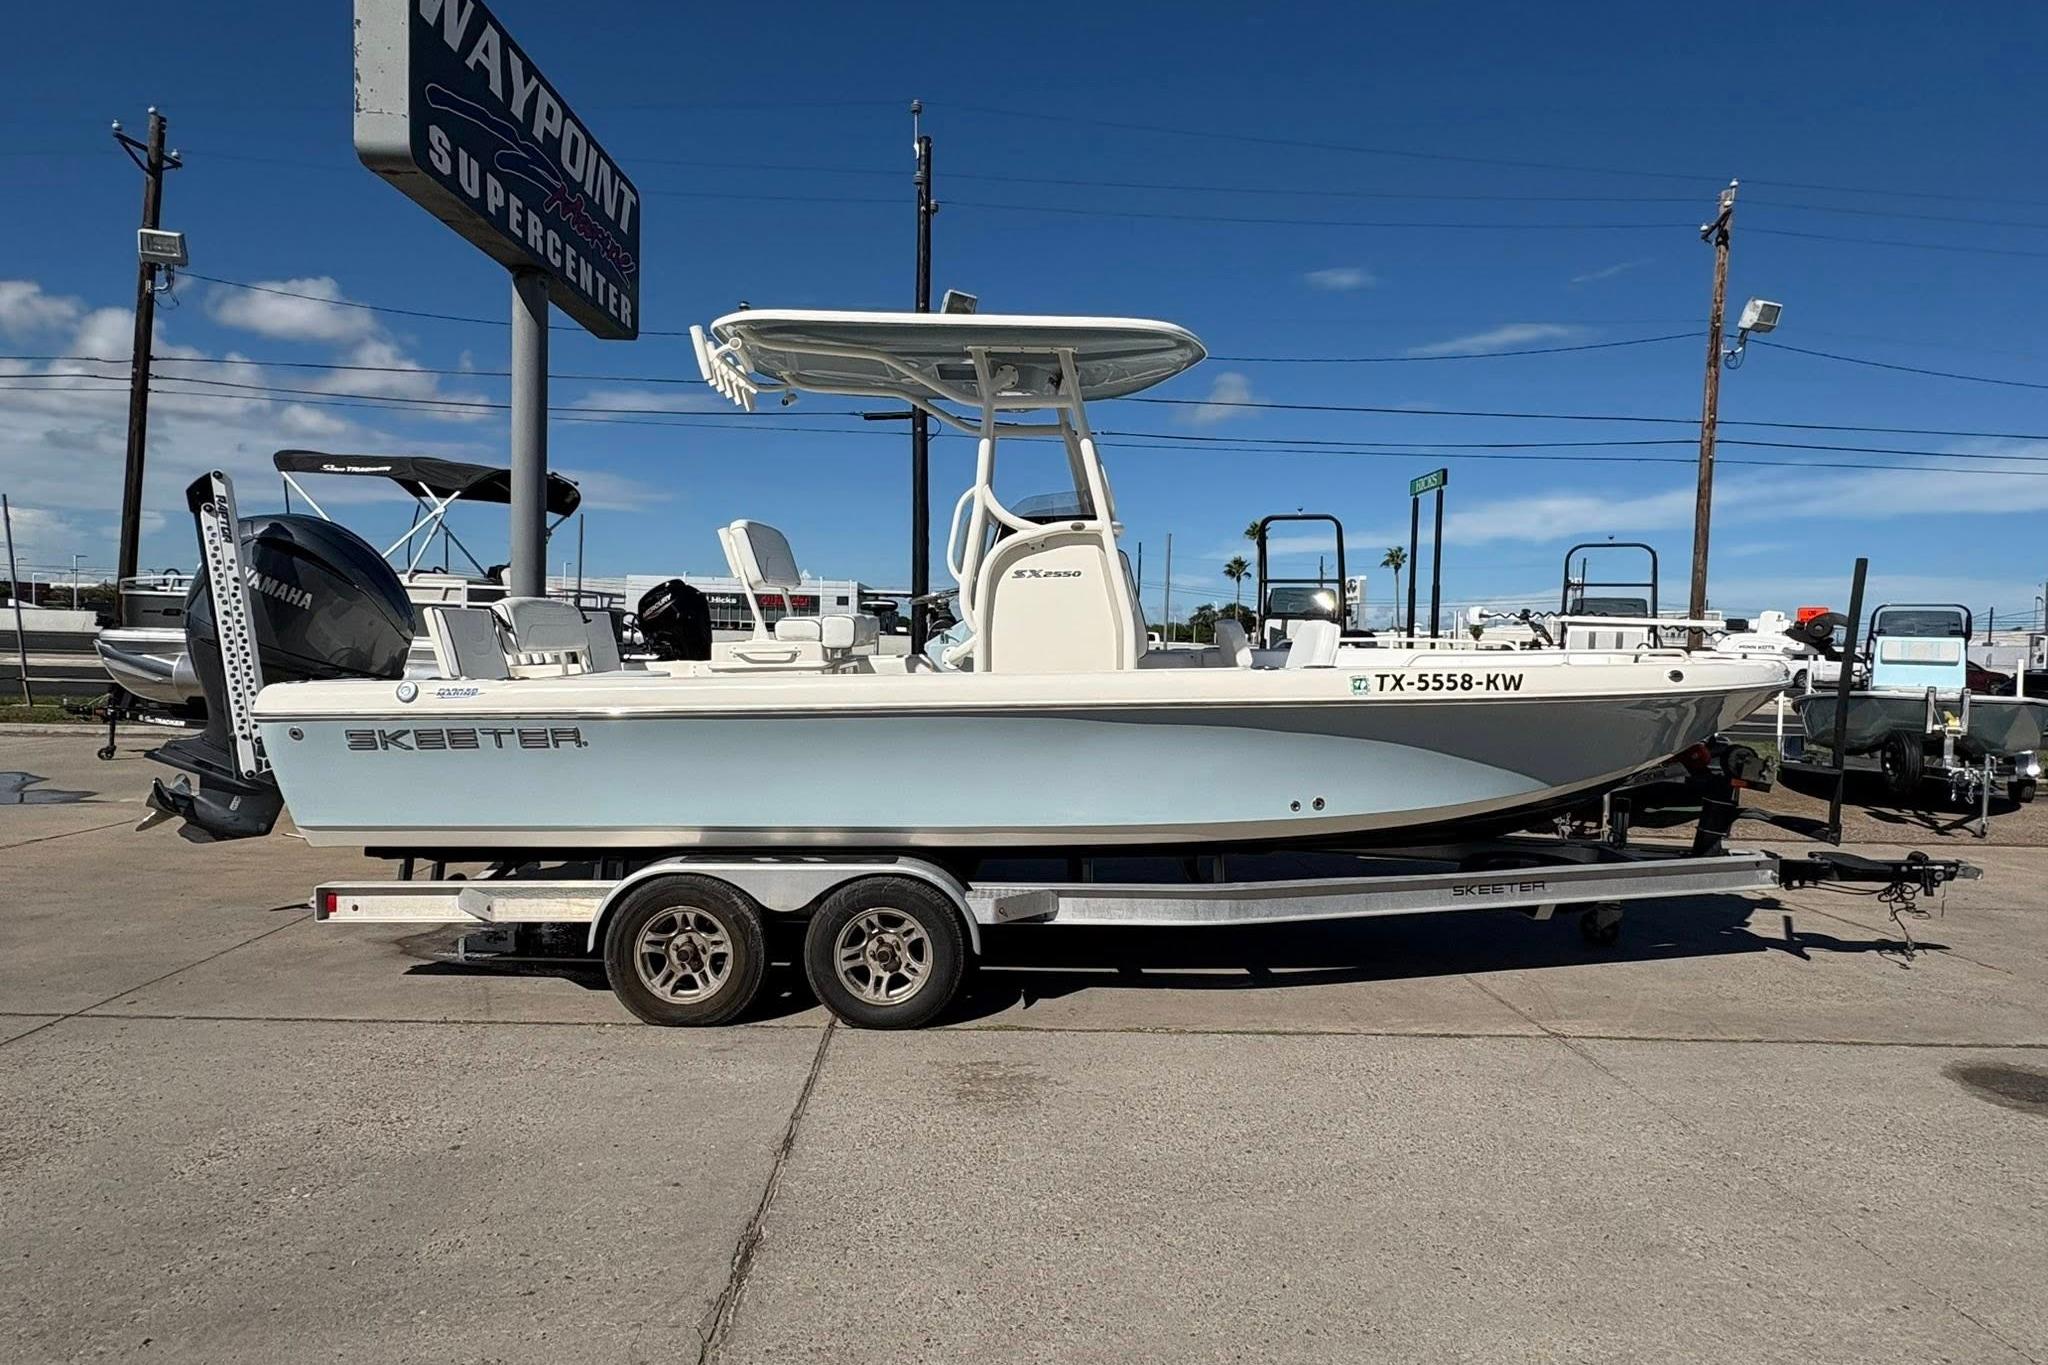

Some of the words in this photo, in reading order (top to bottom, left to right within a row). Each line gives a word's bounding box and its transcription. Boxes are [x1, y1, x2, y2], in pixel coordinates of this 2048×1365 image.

[419, 0, 637, 235] WAYPOINT
[428, 125, 632, 329] SUPERCENTER
[216, 494, 233, 544] RAPTOR
[245, 566, 313, 610] YAMAHA
[1012, 569, 1082, 579] SX2550
[1375, 673, 1524, 692] TX-5558-KW
[345, 727, 583, 750] SKEETER
[1452, 880, 1545, 896] SKEETER
